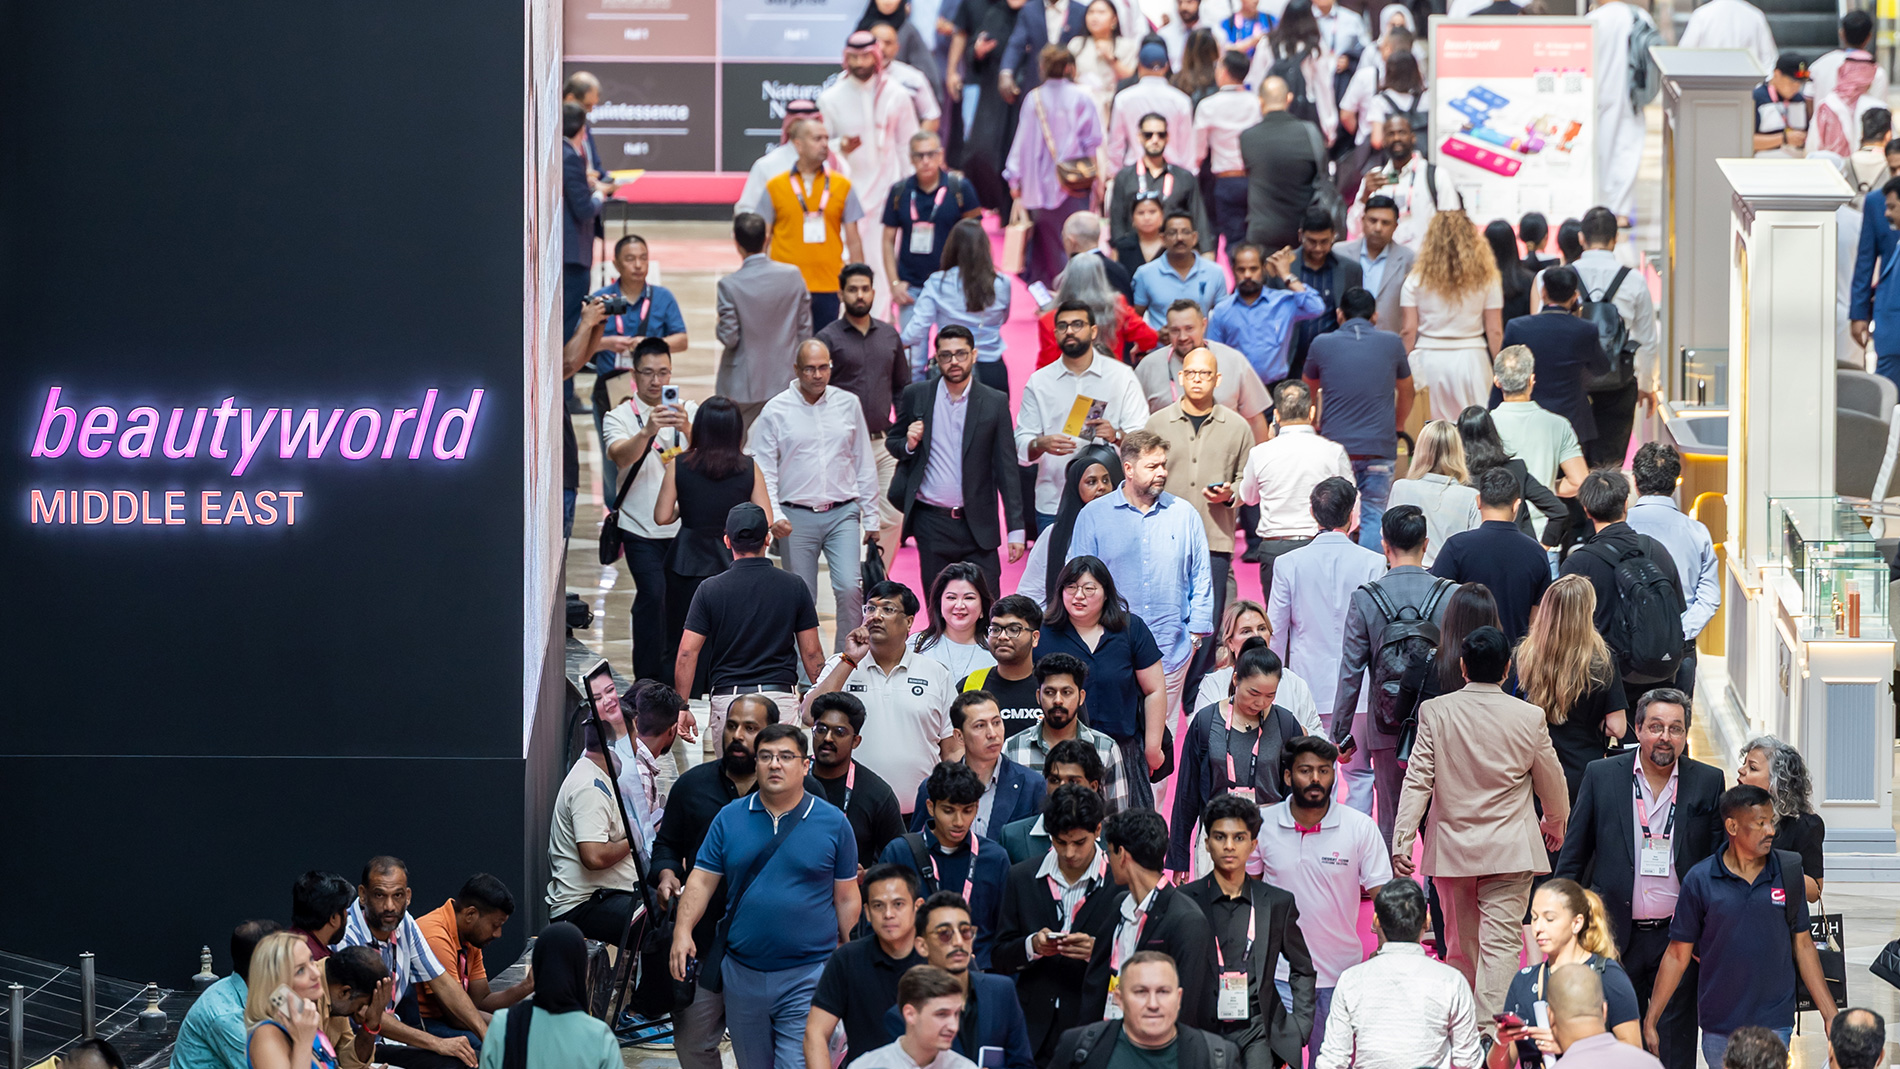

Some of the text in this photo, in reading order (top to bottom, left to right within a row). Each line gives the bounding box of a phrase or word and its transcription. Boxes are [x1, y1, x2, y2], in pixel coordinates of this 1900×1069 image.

[30, 386, 485, 477] beautyworld
[30, 490, 304, 526] MIDDLE EAST
